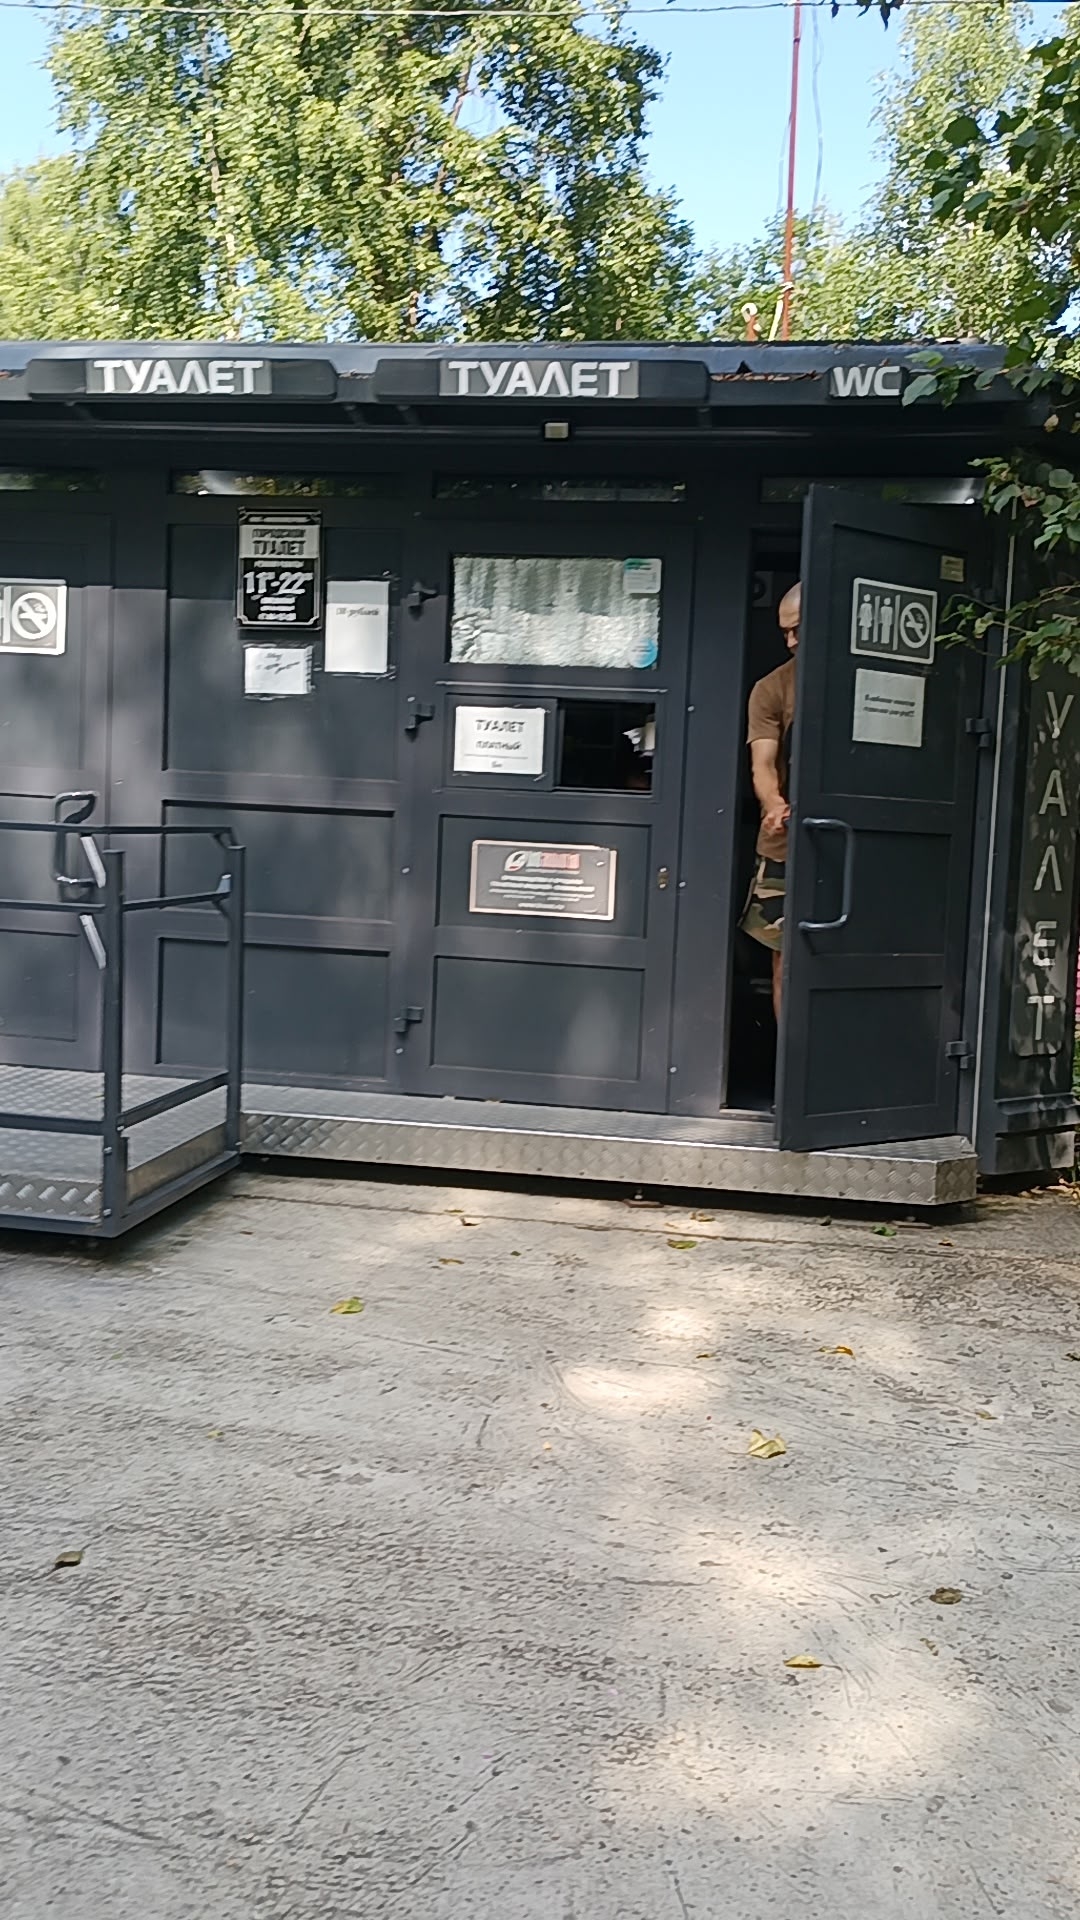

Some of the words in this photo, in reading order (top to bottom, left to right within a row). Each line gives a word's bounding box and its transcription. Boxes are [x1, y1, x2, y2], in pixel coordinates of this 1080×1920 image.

[94, 360, 263, 395] ТУАЛЕТ
[448, 361, 630, 398] ТУАЛЕТ
[833, 366, 900, 397] WC
[476, 719, 526, 733] ТУАЛЕТ
